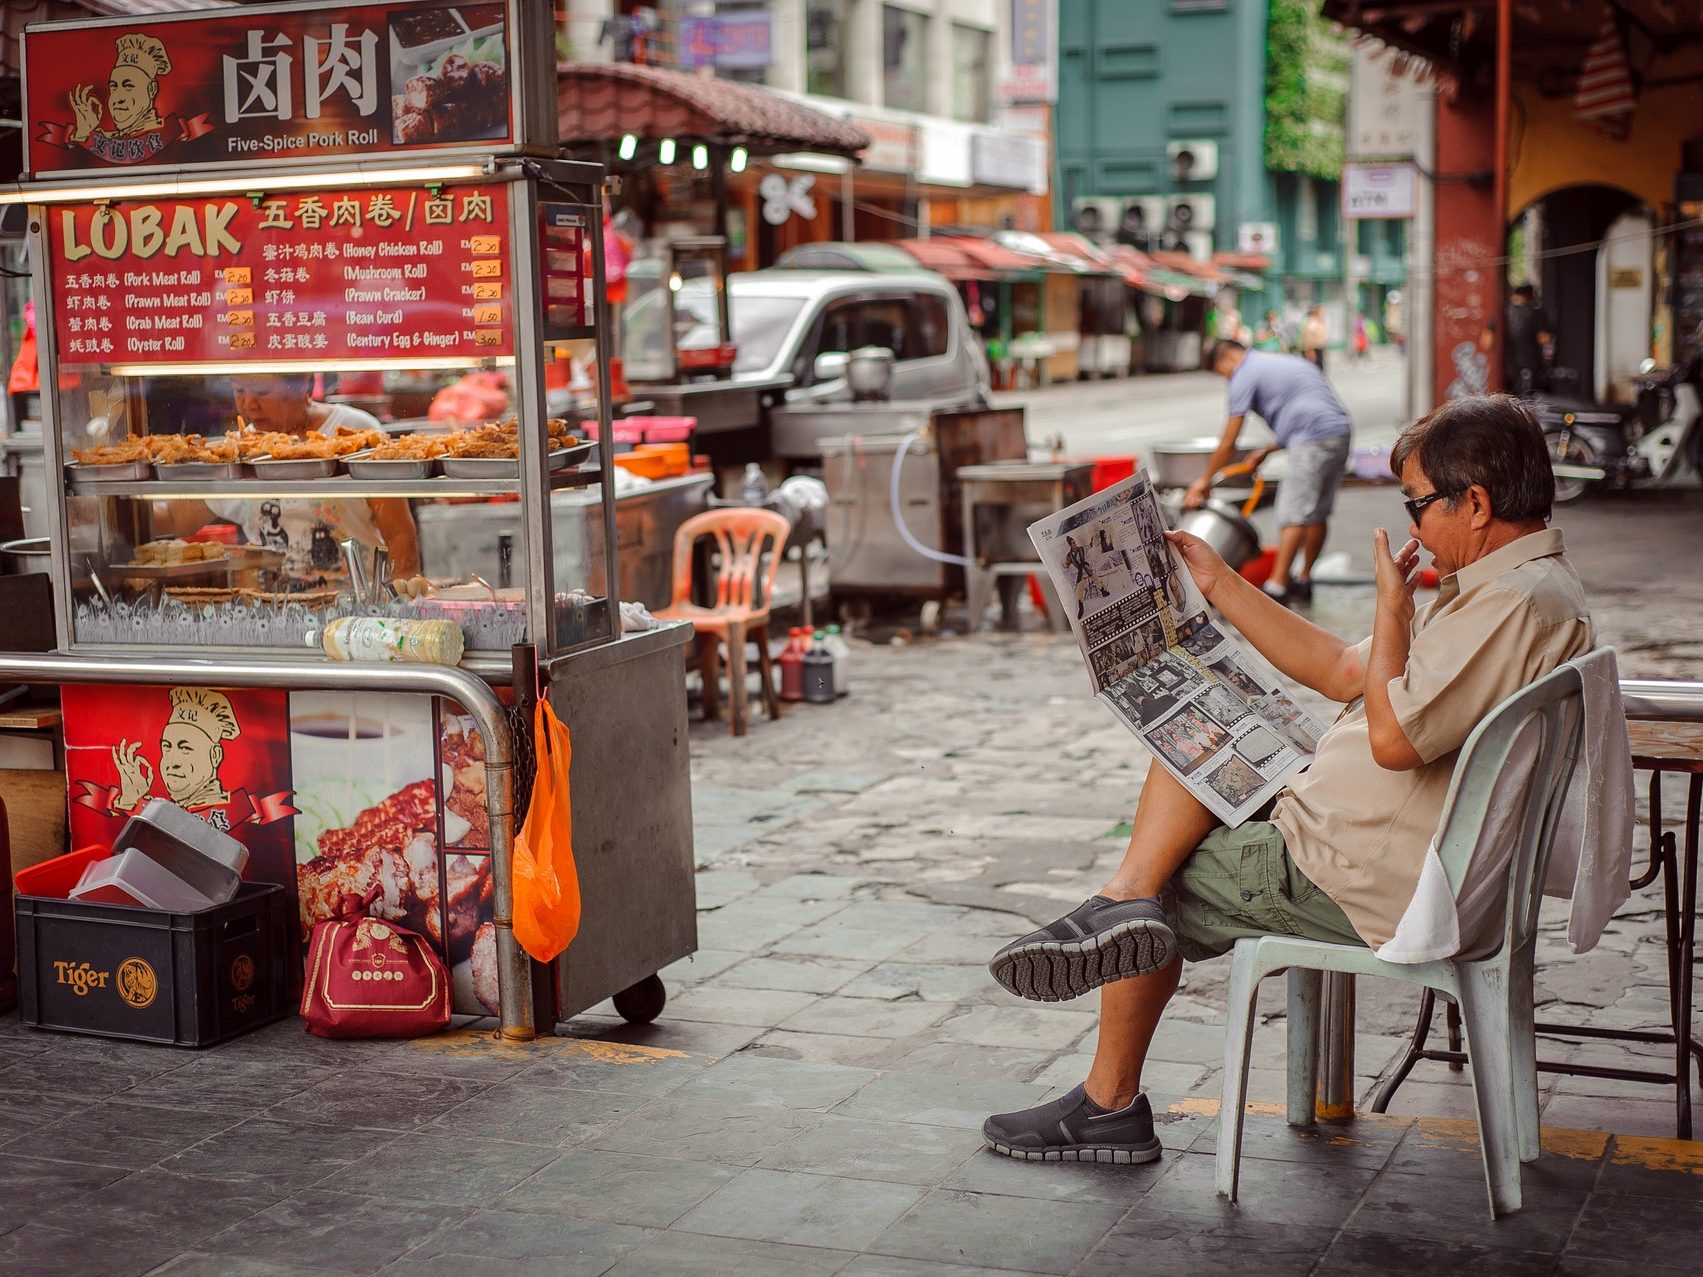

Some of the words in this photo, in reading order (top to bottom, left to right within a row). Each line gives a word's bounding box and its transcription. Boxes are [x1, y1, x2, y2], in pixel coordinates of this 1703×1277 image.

[122, 53, 138, 64] 文记
[223, 23, 379, 123] 卤肉
[228, 134, 304, 152] Five-Spice
[308, 131, 343, 147] Pork
[349, 129, 377, 145] Roll
[62, 202, 241, 260] LOBAK
[263, 242, 339, 261] 蜜汁鸡肉卷
[343, 242, 376, 259] (Honey
[379, 242, 417, 256] Chicken
[420, 240, 443, 255] Roll)
[124, 271, 150, 286] (Pork
[152, 272, 178, 286] Meat
[181, 270, 200, 285] Roll)
[264, 267, 310, 283] 冬菇卷
[344, 265, 401, 280] (Mushroom
[404, 263, 427, 278] Roll)
[65, 273, 119, 289] 五香肉卷
[125, 293, 160, 309] (Prawn
[162, 293, 189, 307] Meat
[191, 291, 211, 307] Roll)
[265, 289, 295, 305] 虾饼
[345, 288, 381, 302] (Prawn
[383, 286, 425, 301] Cracker)
[66, 296, 111, 310] 虾肉卷
[68, 316, 112, 331] 蟹肉卷
[126, 315, 152, 330] (Crab
[155, 315, 180, 329] Meat
[182, 314, 203, 329] Roll)
[266, 311, 326, 327] 五香豆腐
[346, 310, 374, 325] (Bean
[376, 309, 403, 324] Curd)
[127, 337, 163, 353] (Oyster
[165, 336, 185, 351] Roll)
[218, 336, 229, 345] RM
[268, 333, 328, 349] 皮蛋酸姜
[347, 332, 390, 349] (Century
[393, 332, 410, 348] Egg
[413, 333, 422, 346] &
[423, 331, 459, 347] Ginger)
[177, 708, 198, 722] 文记
[54, 961, 110, 996] Tiger
